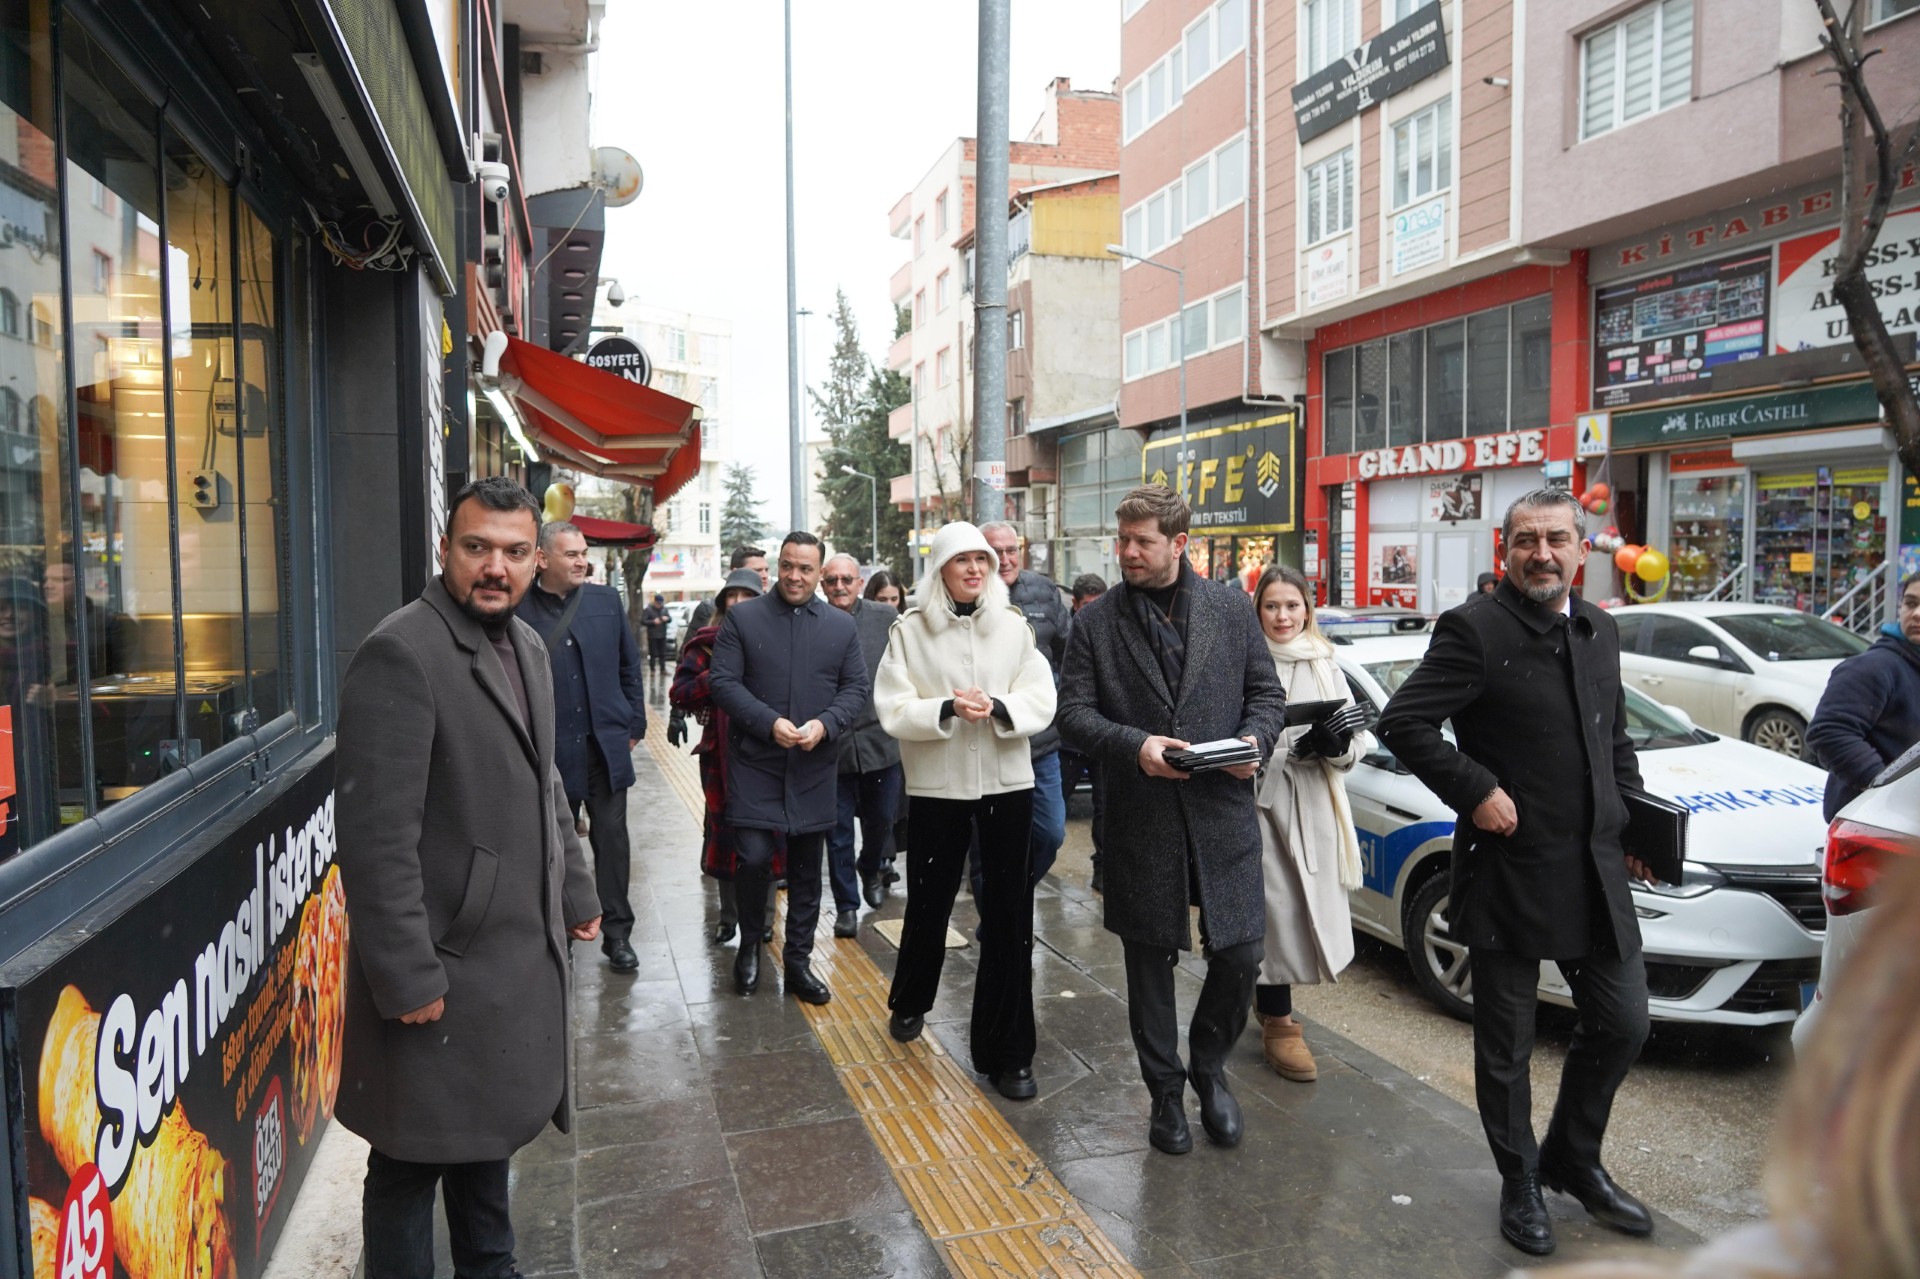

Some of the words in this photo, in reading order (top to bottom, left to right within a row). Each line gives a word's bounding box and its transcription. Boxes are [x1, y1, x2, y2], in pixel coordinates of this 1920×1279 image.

[1340, 56, 1383, 90] YILDIRIM
[588, 353, 640, 367] SOSYETE
[1358, 440, 1466, 479] GRAND
[1473, 430, 1544, 467] EFE
[1176, 455, 1246, 507] EFE
[1202, 512, 1213, 525] EV
[1213, 506, 1248, 524] TEKSTİLİ
[96, 977, 190, 1188] Sen
[195, 841, 265, 1056] nasıl
[268, 788, 337, 946] isterse
[221, 1020, 247, 1088] ister
[277, 937, 296, 988] ister
[235, 1074, 247, 1122] et
[256, 1094, 282, 1173] ÖZEL
[257, 1138, 282, 1217] SOSLU
[61, 1171, 105, 1279] 45
